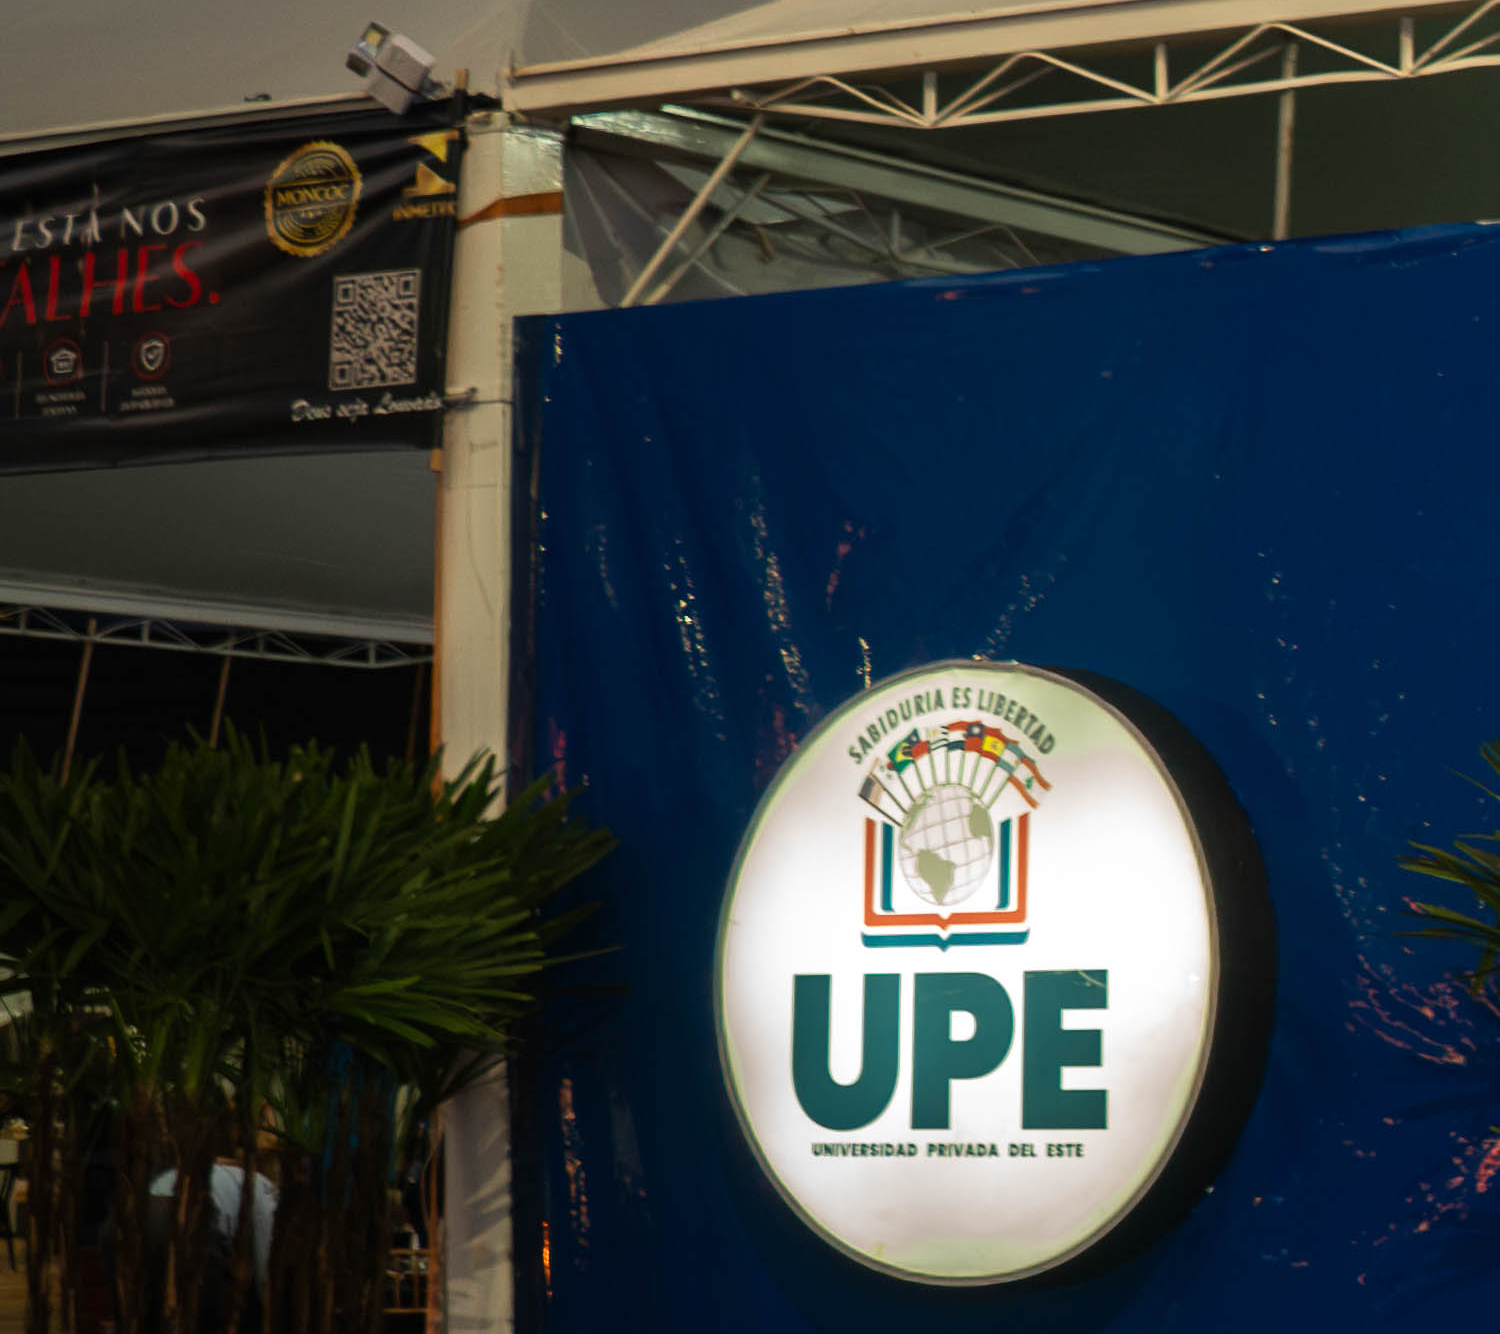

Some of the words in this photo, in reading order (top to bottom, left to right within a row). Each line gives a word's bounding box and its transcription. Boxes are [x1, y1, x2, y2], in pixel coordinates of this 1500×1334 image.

[119, 197, 207, 240] NOS
[0, 240, 220, 329] ALHES.
[848, 688, 945, 765] SABIDURIA
[952, 686, 973, 709] ES
[977, 688, 1056, 755] LIBERTAD
[791, 969, 1109, 1132] UPE
[811, 1142, 918, 1158] UNIVERSIDAD
[927, 1142, 999, 1158] PRIVADA
[1008, 1142, 1037, 1158] DEL
[1046, 1142, 1084, 1158] ESTE
